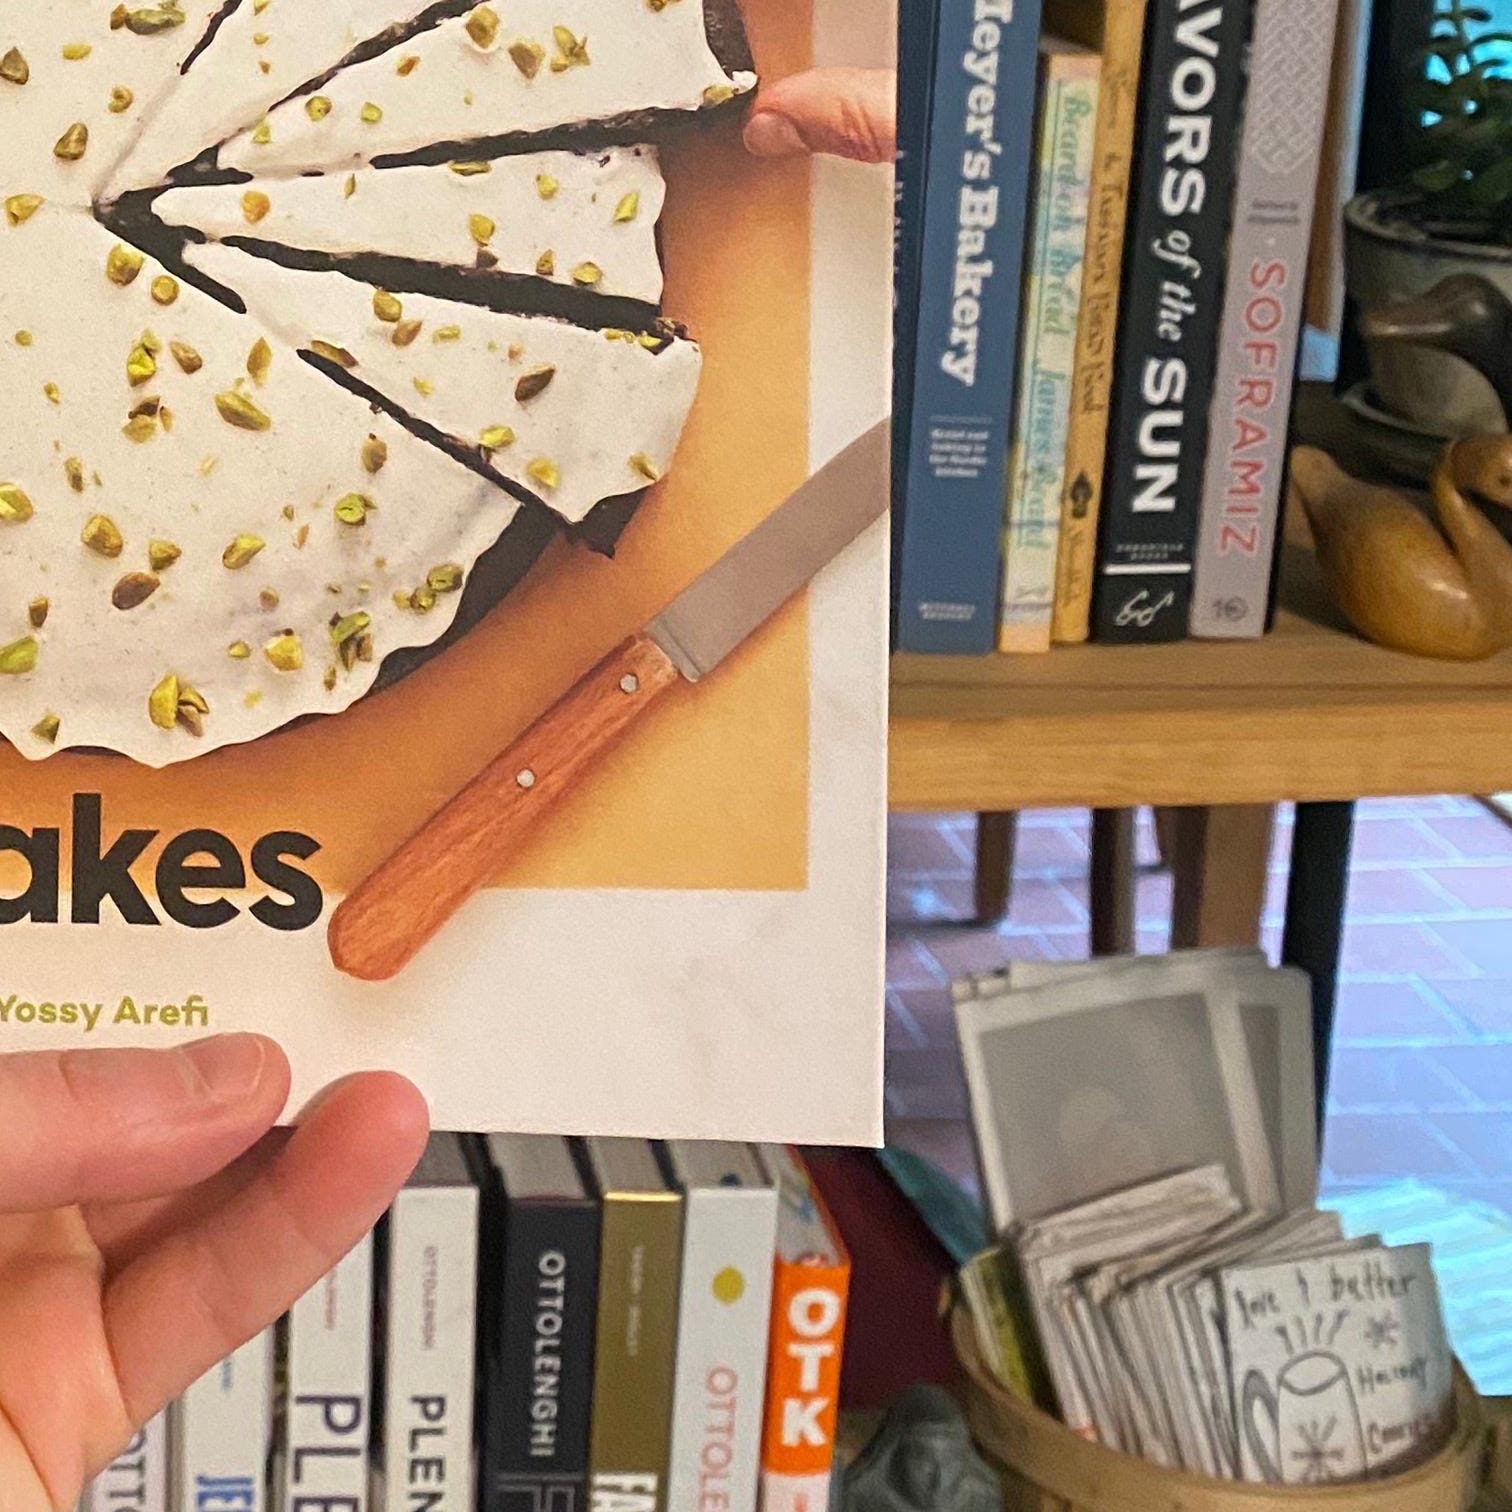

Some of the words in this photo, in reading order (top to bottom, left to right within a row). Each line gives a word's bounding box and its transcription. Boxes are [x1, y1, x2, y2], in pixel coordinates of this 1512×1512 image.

[940, 184, 1000, 388] Bakery
[1152, 228, 1203, 279] of
[1157, 280, 1197, 343] the
[1130, 355, 1189, 514] SUN
[1219, 259, 1289, 558] SOFRAMIZ
[113, 994, 210, 1027] Arefi
[529, 1249, 567, 1457] OTTOLENGHI
[780, 1287, 842, 1448] OTK
[407, 1393, 447, 1512] PLEN
[698, 1364, 739, 1512] OTTOLE
